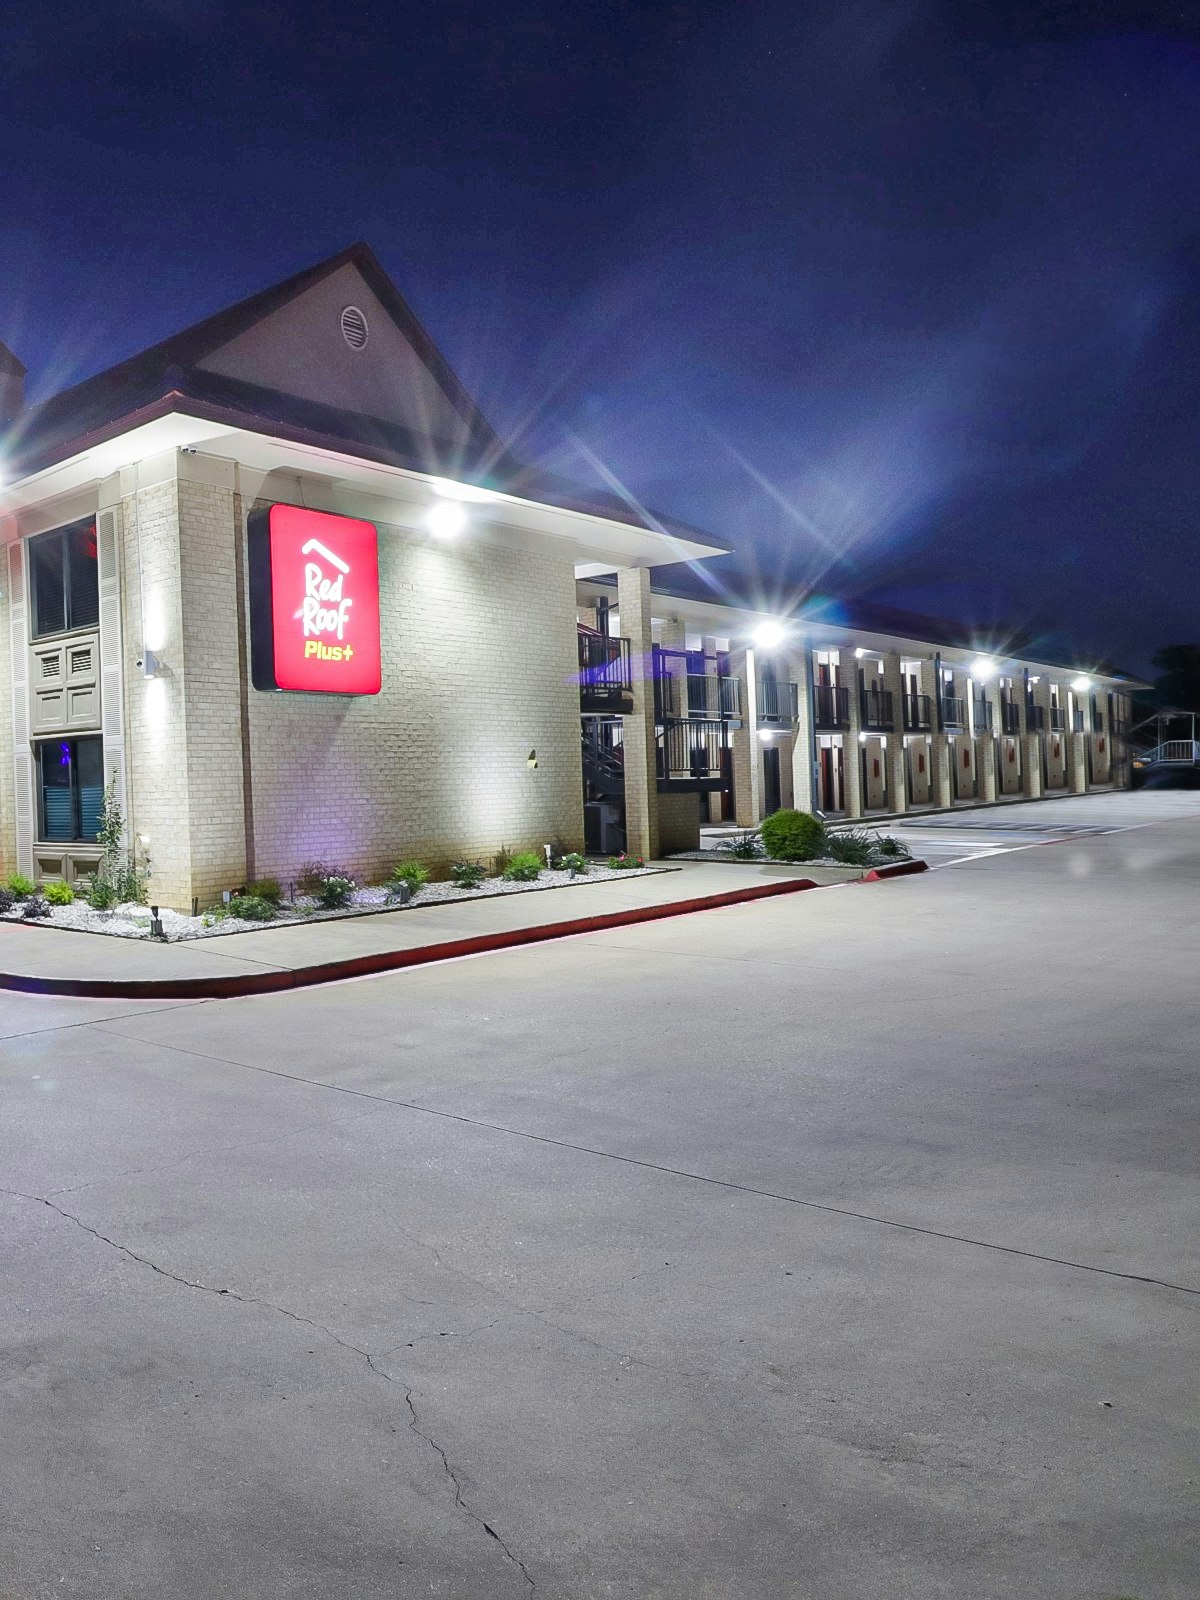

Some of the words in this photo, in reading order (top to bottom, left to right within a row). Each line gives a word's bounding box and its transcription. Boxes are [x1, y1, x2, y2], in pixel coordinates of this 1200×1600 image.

[305, 562, 343, 600] Red
[303, 596, 352, 640] Roof
[304, 640, 354, 661] Plus+
